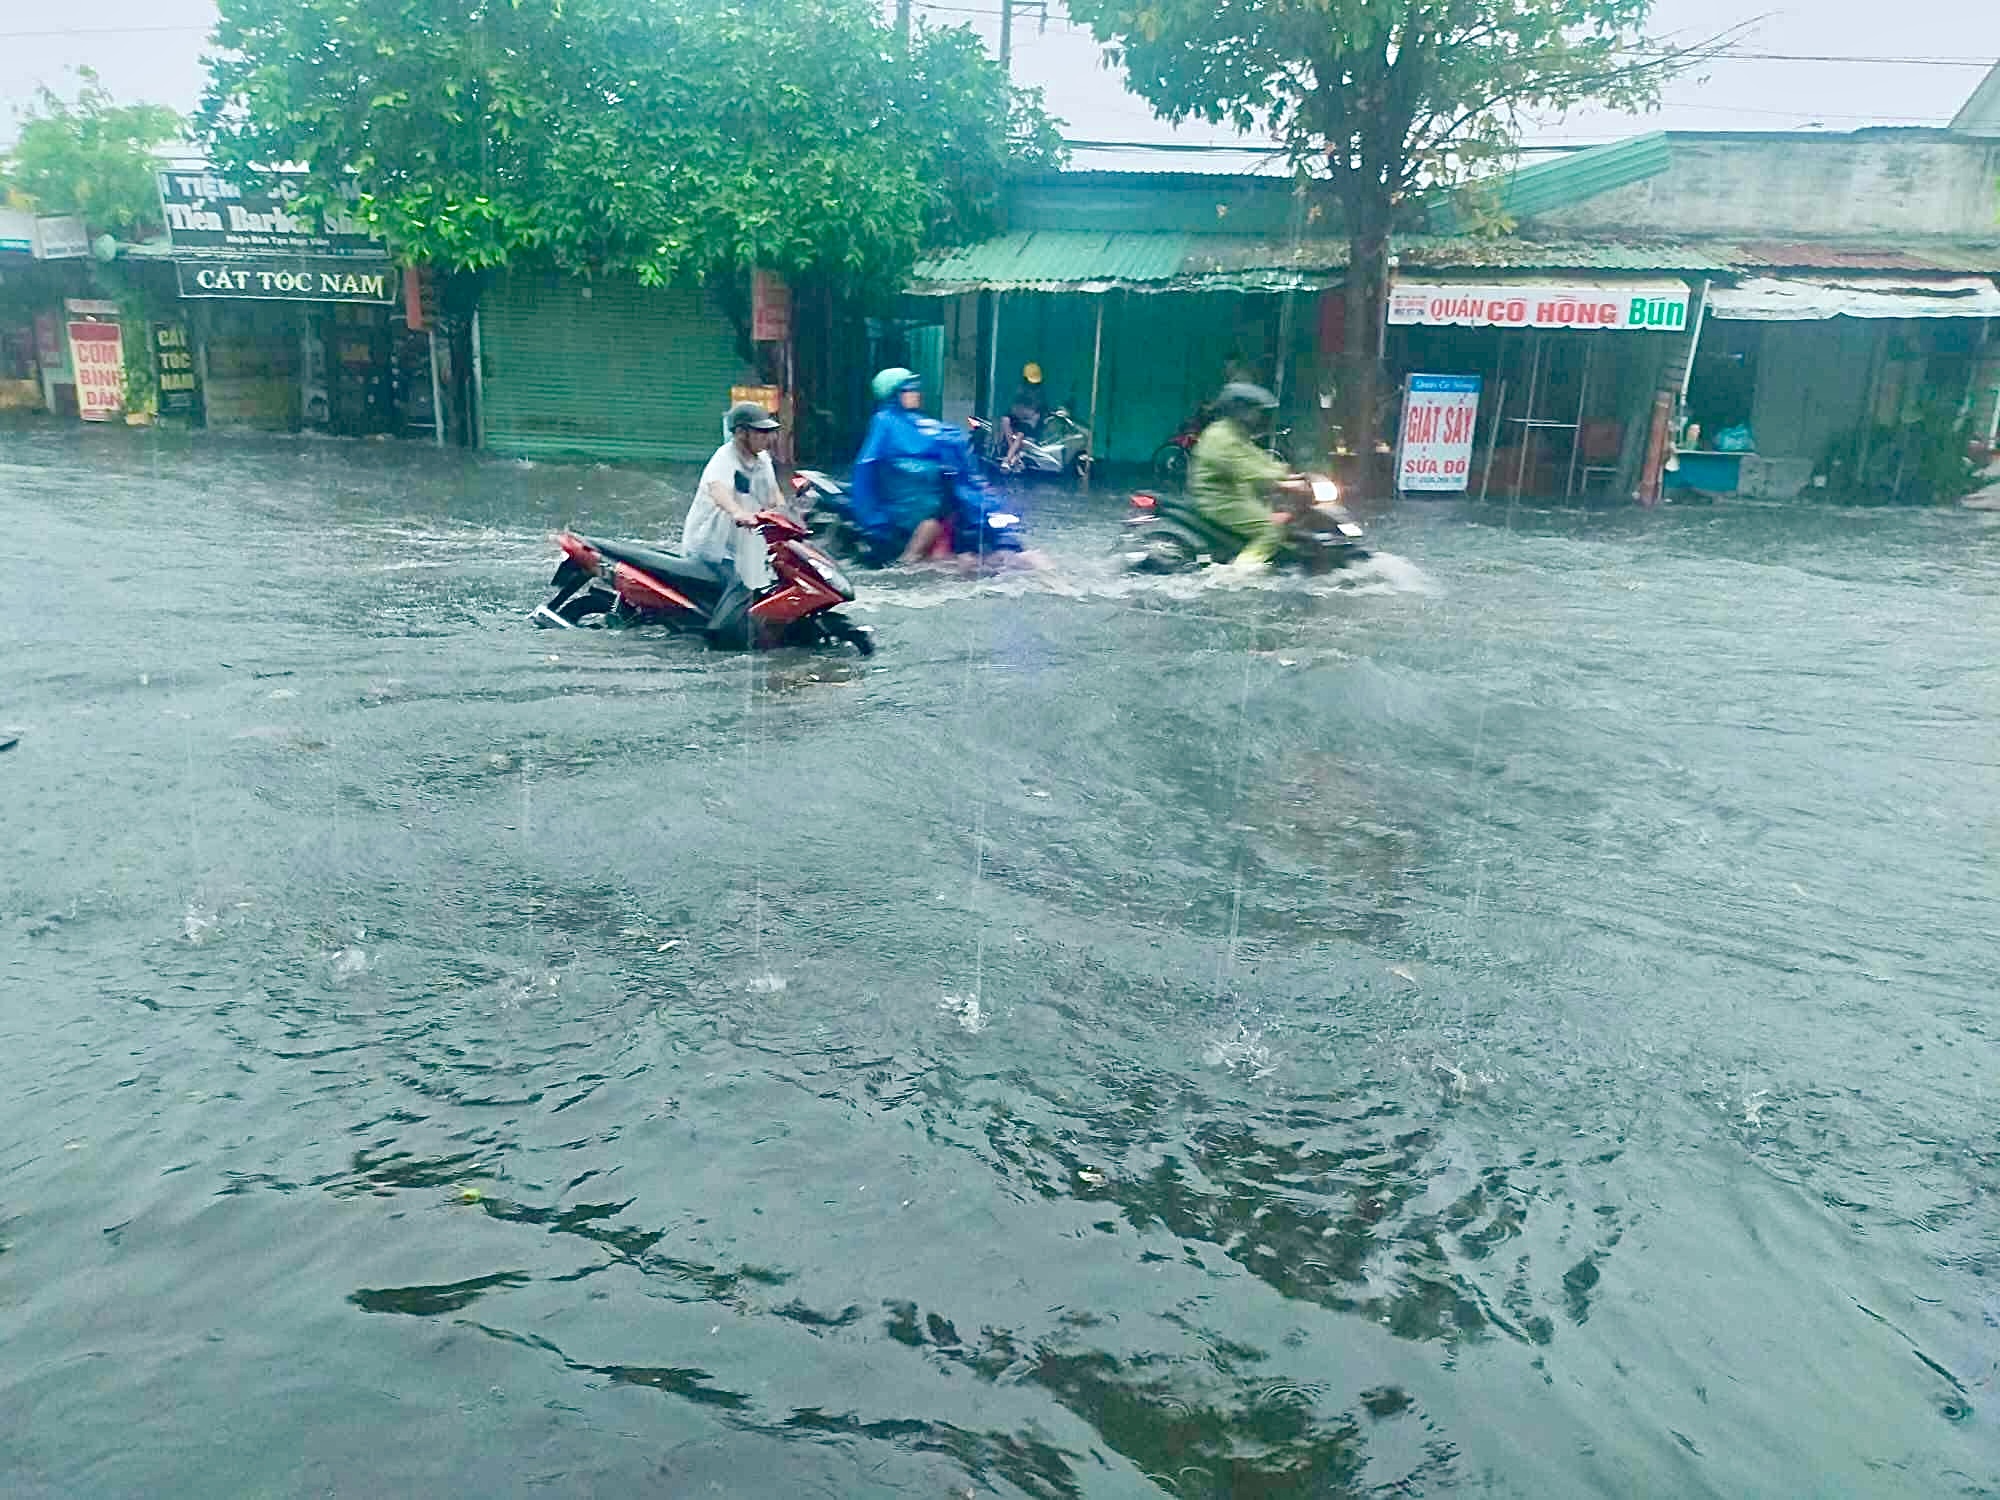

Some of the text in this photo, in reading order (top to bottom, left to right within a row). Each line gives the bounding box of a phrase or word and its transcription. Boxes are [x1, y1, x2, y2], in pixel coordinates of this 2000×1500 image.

[256, 269, 313, 292] TÓC
[319, 272, 384, 299] NAM
[1431, 293, 1484, 321] QUÁN
[1487, 297, 1527, 322] CÔ
[1628, 296, 1684, 326] Bún
